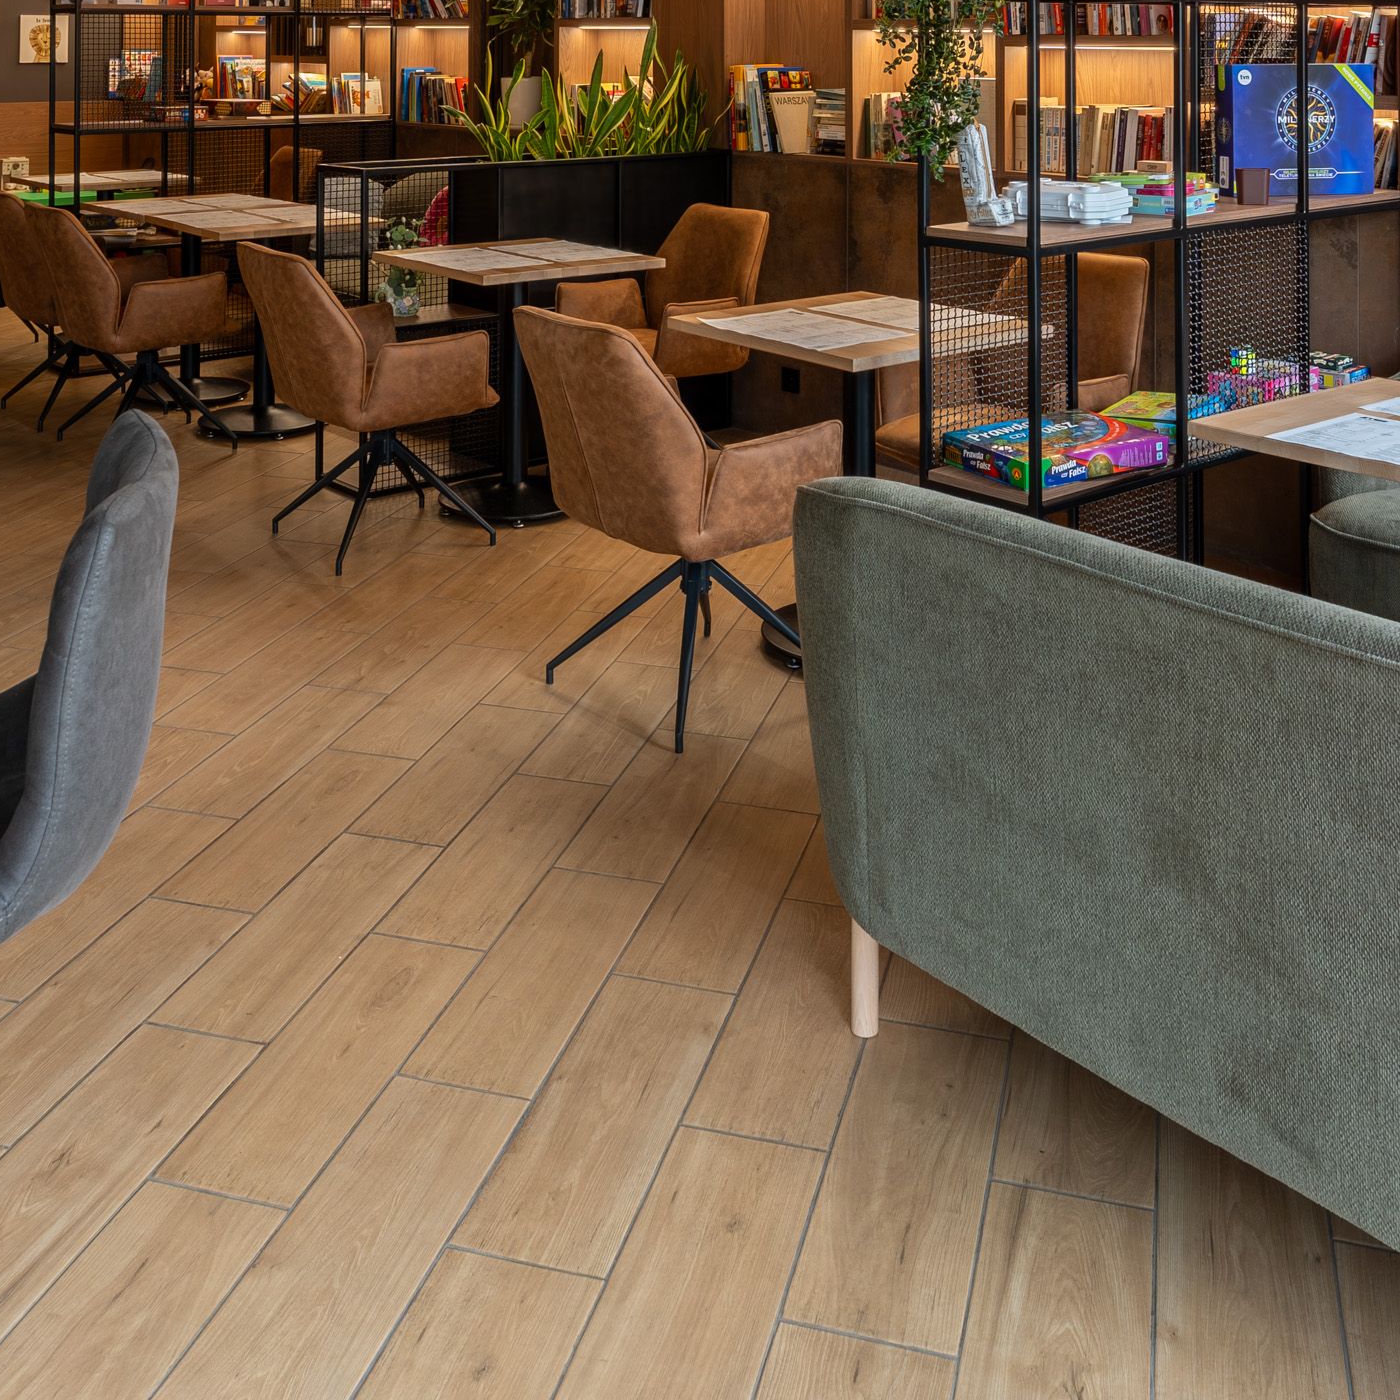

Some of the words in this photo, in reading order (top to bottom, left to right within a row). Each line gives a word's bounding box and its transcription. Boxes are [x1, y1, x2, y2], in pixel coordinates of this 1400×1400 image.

[1277, 115, 1336, 124] MILNERZY
[1041, 420, 1079, 435] ałsz
[963, 449, 984, 460] Prawda
[1051, 460, 1077, 475] Prawda
